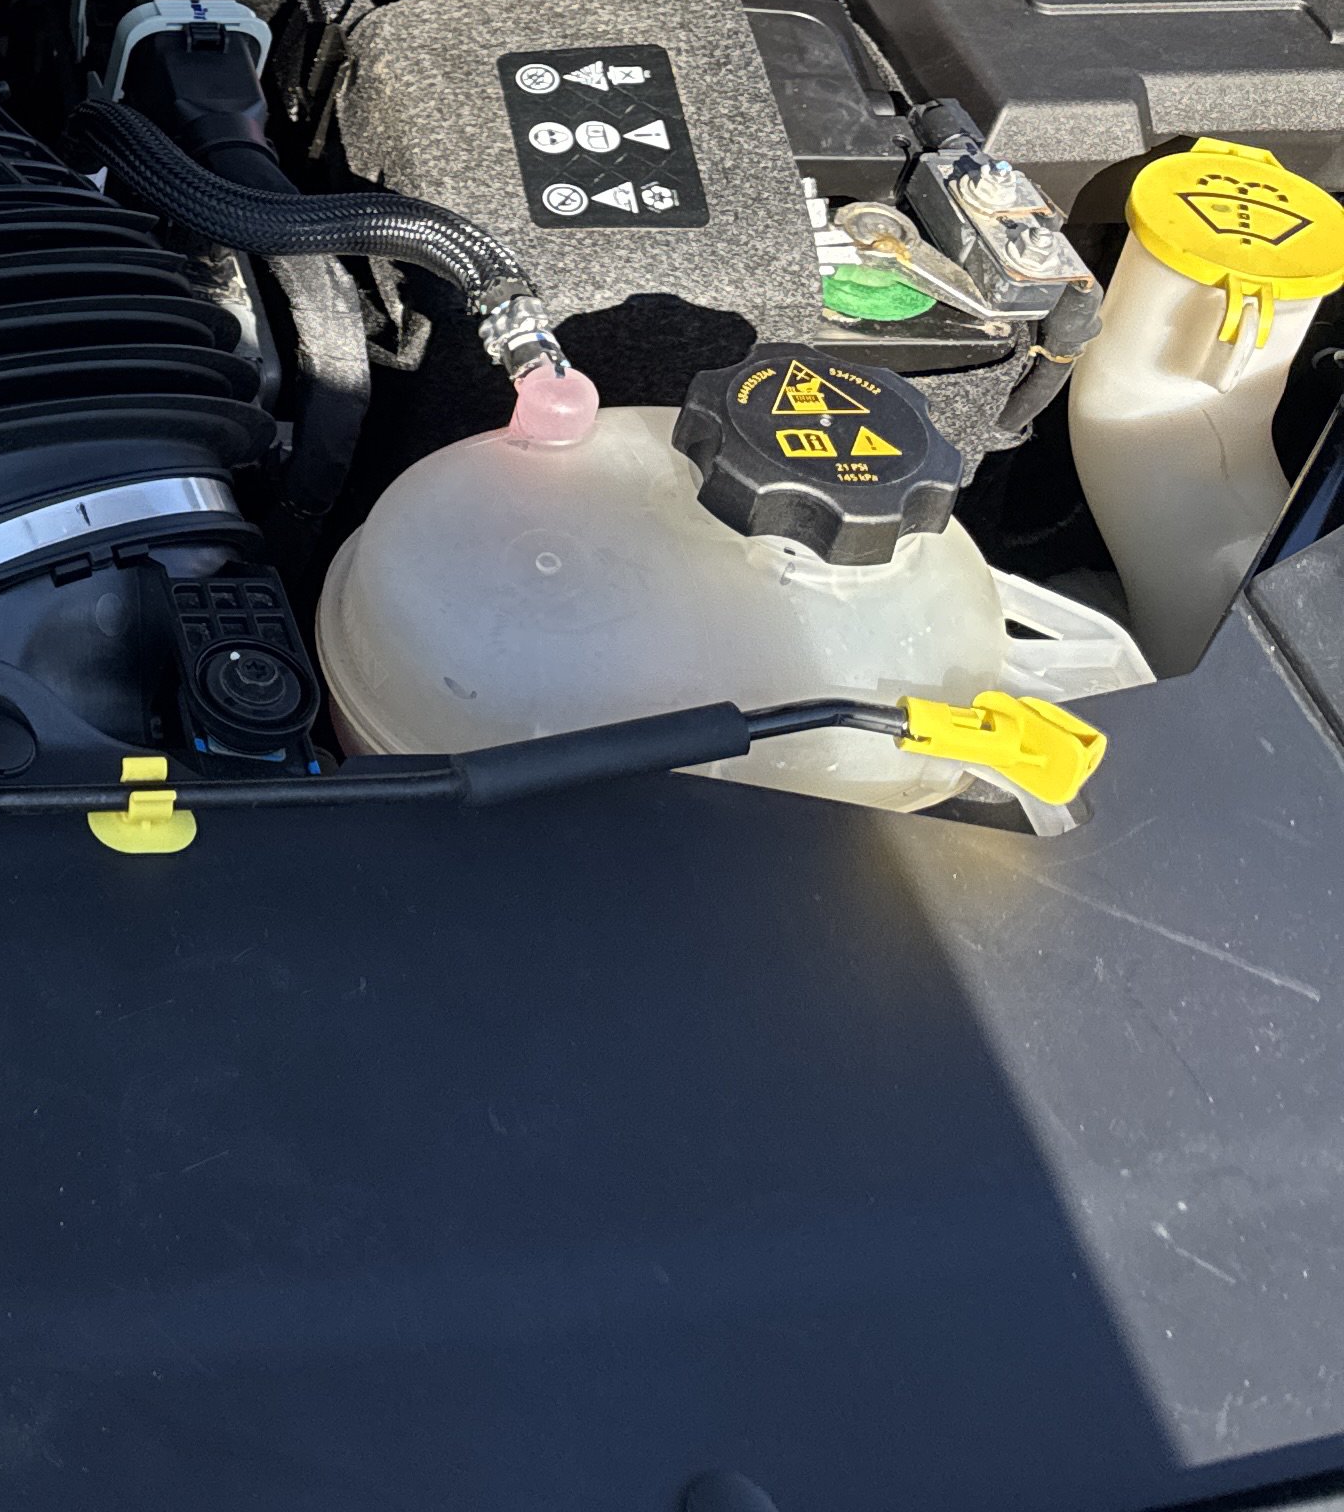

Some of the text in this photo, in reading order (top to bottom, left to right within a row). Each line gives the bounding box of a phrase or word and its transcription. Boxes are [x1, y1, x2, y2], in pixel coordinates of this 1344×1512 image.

[835, 462, 869, 472] 21 PSI
[837, 473, 879, 483] 145 kPa
